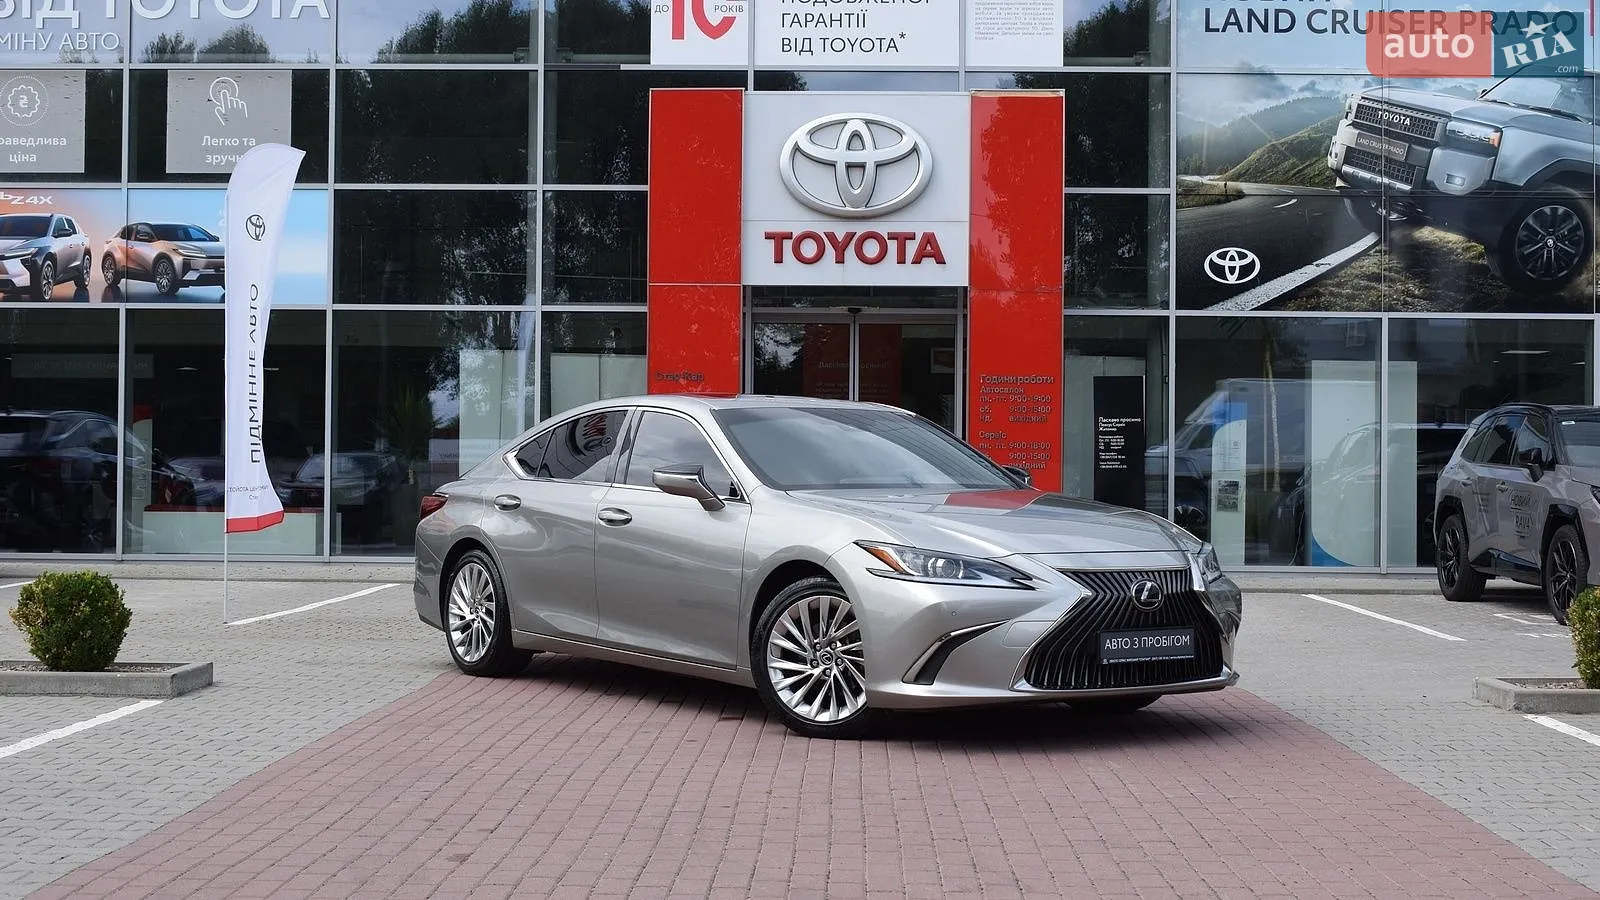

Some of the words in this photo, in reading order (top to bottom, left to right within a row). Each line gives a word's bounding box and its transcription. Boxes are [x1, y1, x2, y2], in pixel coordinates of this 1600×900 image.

[654, 4, 670, 13] ДО
[714, 4, 744, 13] РОКІВ
[780, 9, 867, 29] ГАРАНТІЇ
[1203, 7, 1297, 34] LAND
[1305, 8, 1448, 36] CRUISER
[1459, 9, 1579, 37] PRADO
[58, 32, 121, 51] АВТО
[780, 37, 814, 56] ВІД
[1377, 110, 1411, 126] TOYOTA
[201, 135, 240, 147] Легко
[242, 137, 257, 147] та
[1357, 137, 1369, 146] LAND
[9, 151, 37, 165] ціна
[764, 230, 947, 265] TOYOTA
[248, 284, 259, 344] АВТО
[980, 374, 1017, 385] Години
[1017, 374, 1054, 385] роботи
[248, 349, 262, 464] ПІДМІННЕ
[979, 430, 1007, 441] Сервіс
[1104, 638, 1131, 650] АВТО
[1141, 635, 1190, 648] ПРОБІГОМ
